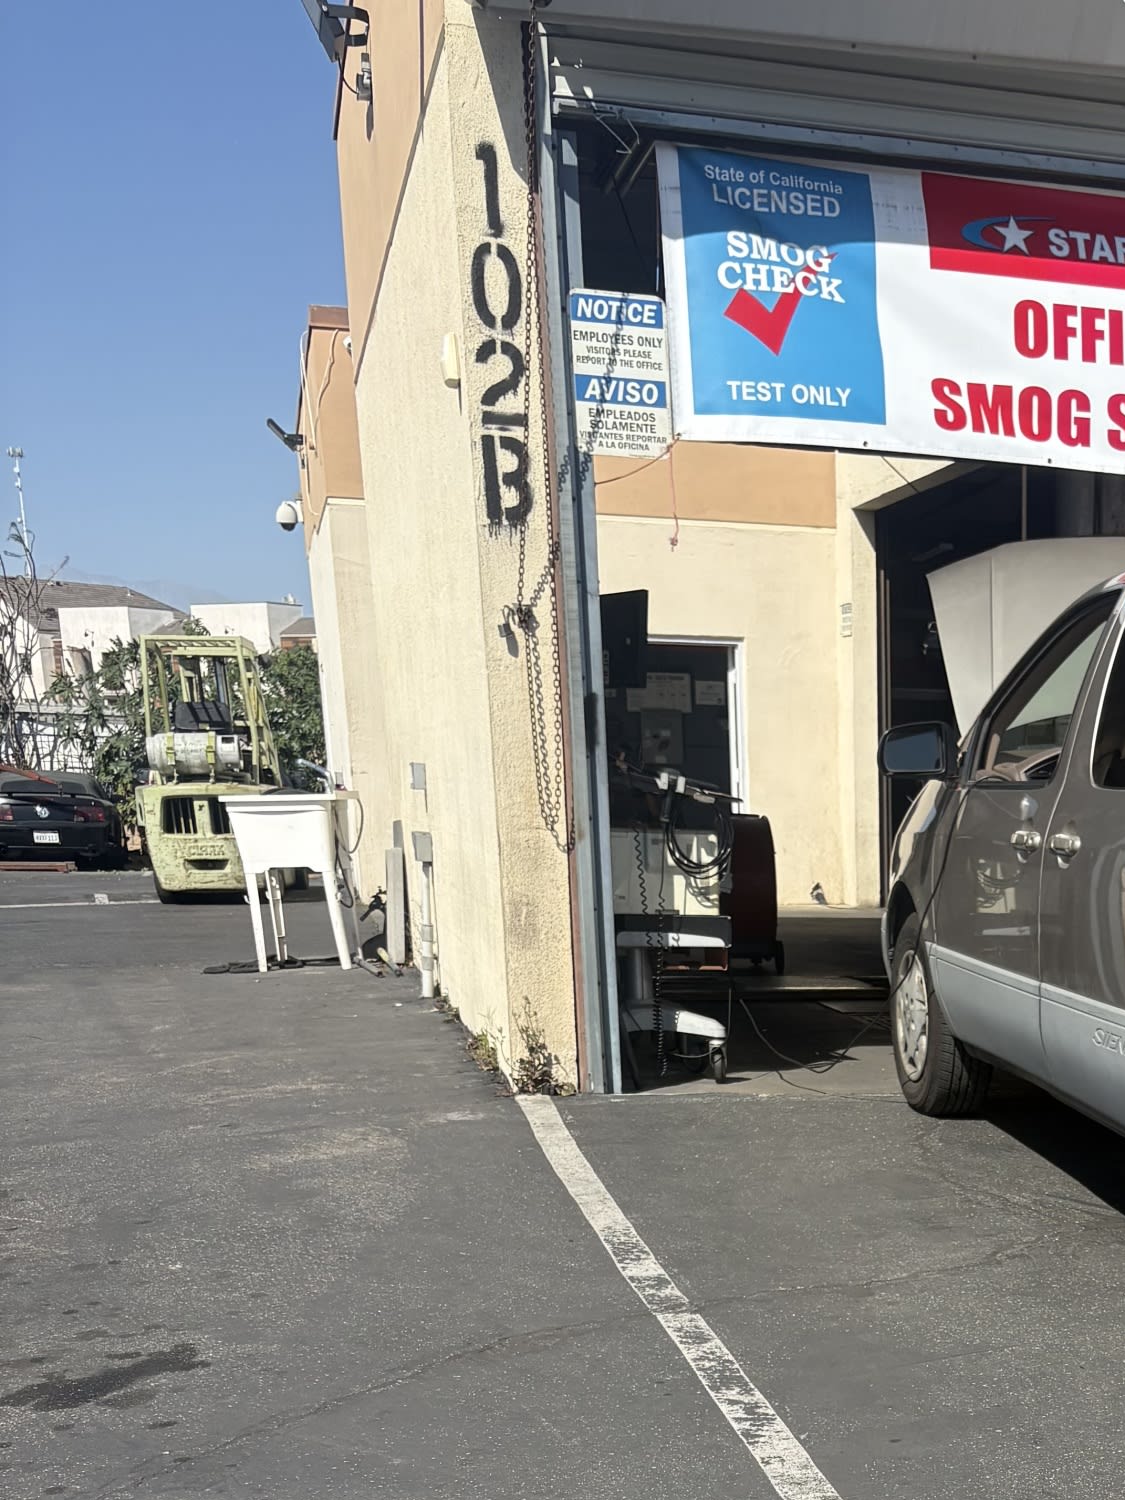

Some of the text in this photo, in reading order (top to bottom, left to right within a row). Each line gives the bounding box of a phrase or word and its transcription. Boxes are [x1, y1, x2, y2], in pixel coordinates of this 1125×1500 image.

[704, 165, 843, 195] State of California
[711, 183, 841, 217] LICENSED
[726, 230, 832, 274] SMOG
[717, 260, 846, 304] CHECK
[577, 297, 657, 324] NOTICE
[623, 349, 652, 359] PLEASE
[637, 336, 663, 348] ONLY
[576, 355, 606, 365] REPORT
[619, 359, 634, 369] THE
[636, 361, 663, 371] OFFICE
[584, 378, 659, 405] AVISO
[726, 380, 852, 408] TEST ONLY
[931, 377, 1091, 448] SMOG
[606, 441, 616, 449] LA
[618, 442, 650, 451] OFICINA
[626, 434, 667, 444] REPORTAR
